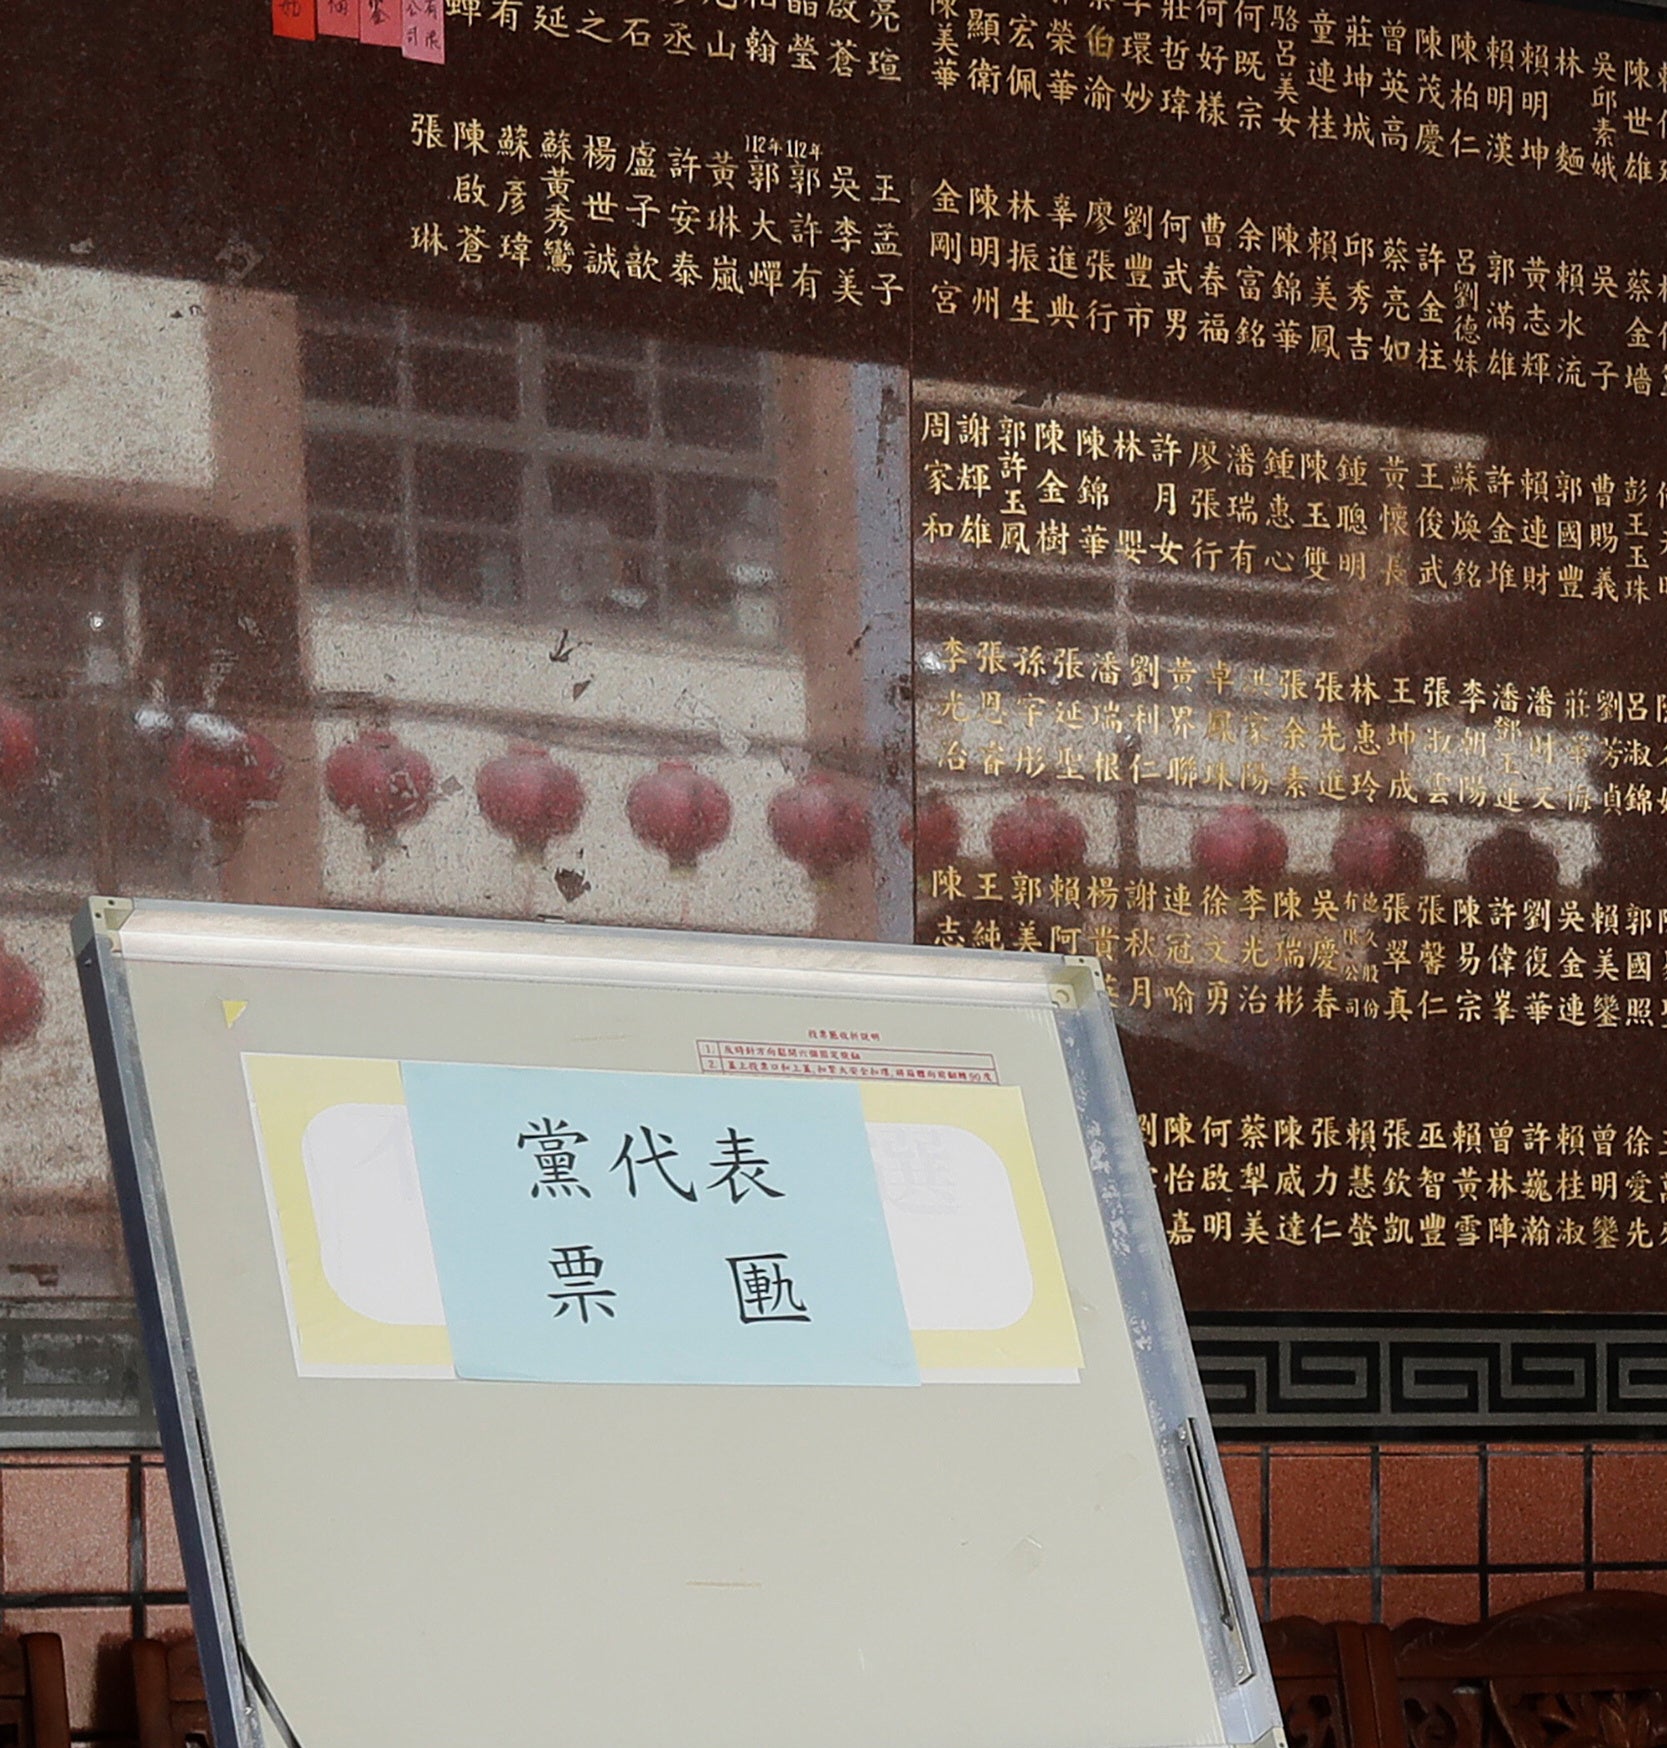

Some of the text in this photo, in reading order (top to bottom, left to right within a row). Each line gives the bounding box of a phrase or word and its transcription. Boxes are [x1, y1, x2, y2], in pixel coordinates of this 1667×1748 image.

[1380, 20, 1410, 153] 曾英高
[1449, 30, 1482, 157] 陳柏仁
[1622, 57, 1654, 182] 陳世雄
[581, 134, 621, 281] 楊世誠
[667, 145, 704, 287] 許安泰
[829, 164, 864, 306] 吳李美
[968, 182, 1002, 321] 陳明州
[1005, 190, 1042, 325] 林振生
[1159, 208, 1194, 343] 何武男
[1198, 211, 1231, 345] 曹春福
[1342, 236, 1375, 362] 邱秀吉
[1414, 242, 1448, 371] 許金柱
[1521, 256, 1552, 379] 黃志輝
[921, 410, 955, 544] 周家和
[955, 412, 993, 547] 謝輝雄
[1034, 420, 1071, 557] 陳金樹
[1148, 432, 1185, 566] 許月女
[1417, 461, 1449, 590] 王俊武
[1454, 894, 1484, 1023] 陳易宗
[1558, 899, 1588, 1028] 吳金連
[516, 1115, 785, 1206] 黨代表
[1310, 1115, 1343, 1243] 張力仁
[1623, 1124, 1655, 1250] 徐愛先
